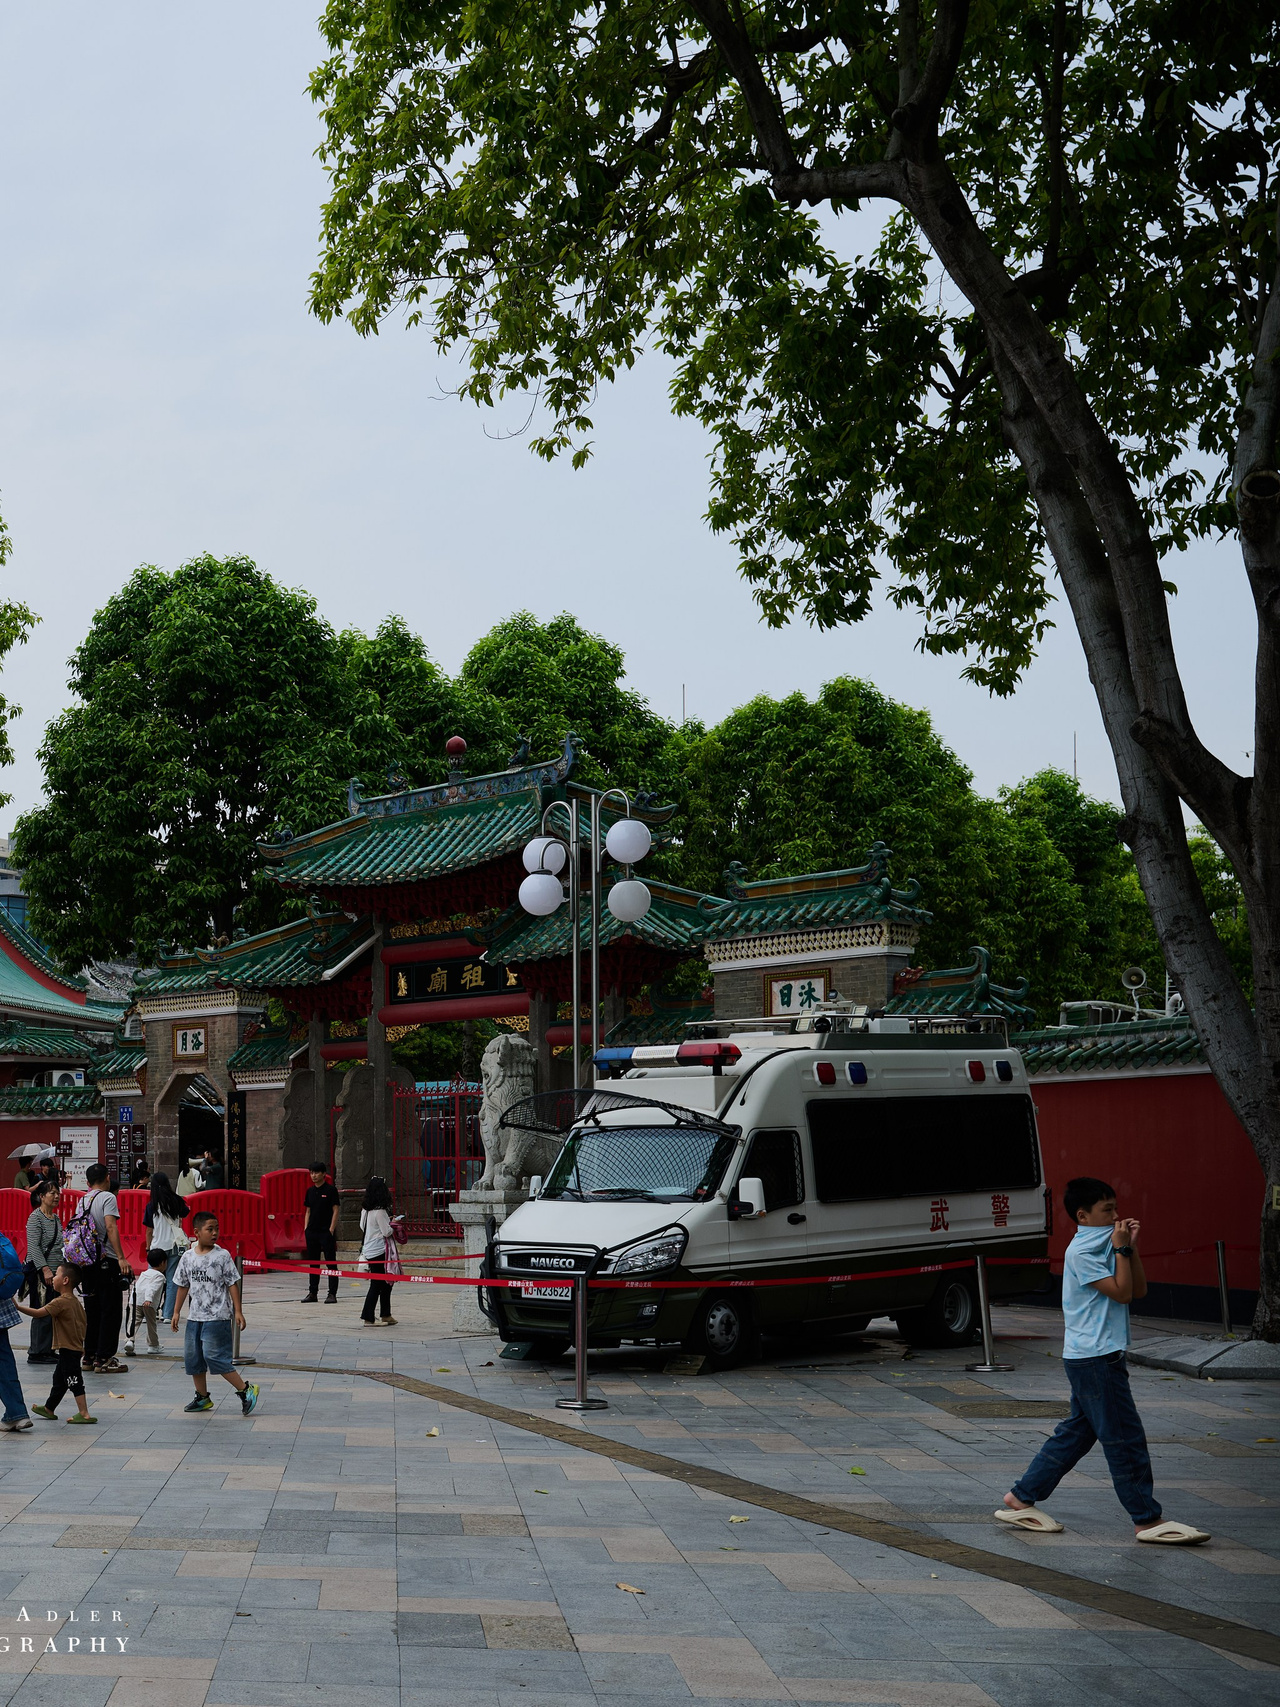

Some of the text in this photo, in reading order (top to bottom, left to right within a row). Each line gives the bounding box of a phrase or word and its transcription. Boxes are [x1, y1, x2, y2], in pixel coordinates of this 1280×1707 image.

[122, 1112, 130, 1121] 21
[929, 1194, 1010, 1232] 武警
[530, 1257, 575, 1269] NAVECO
